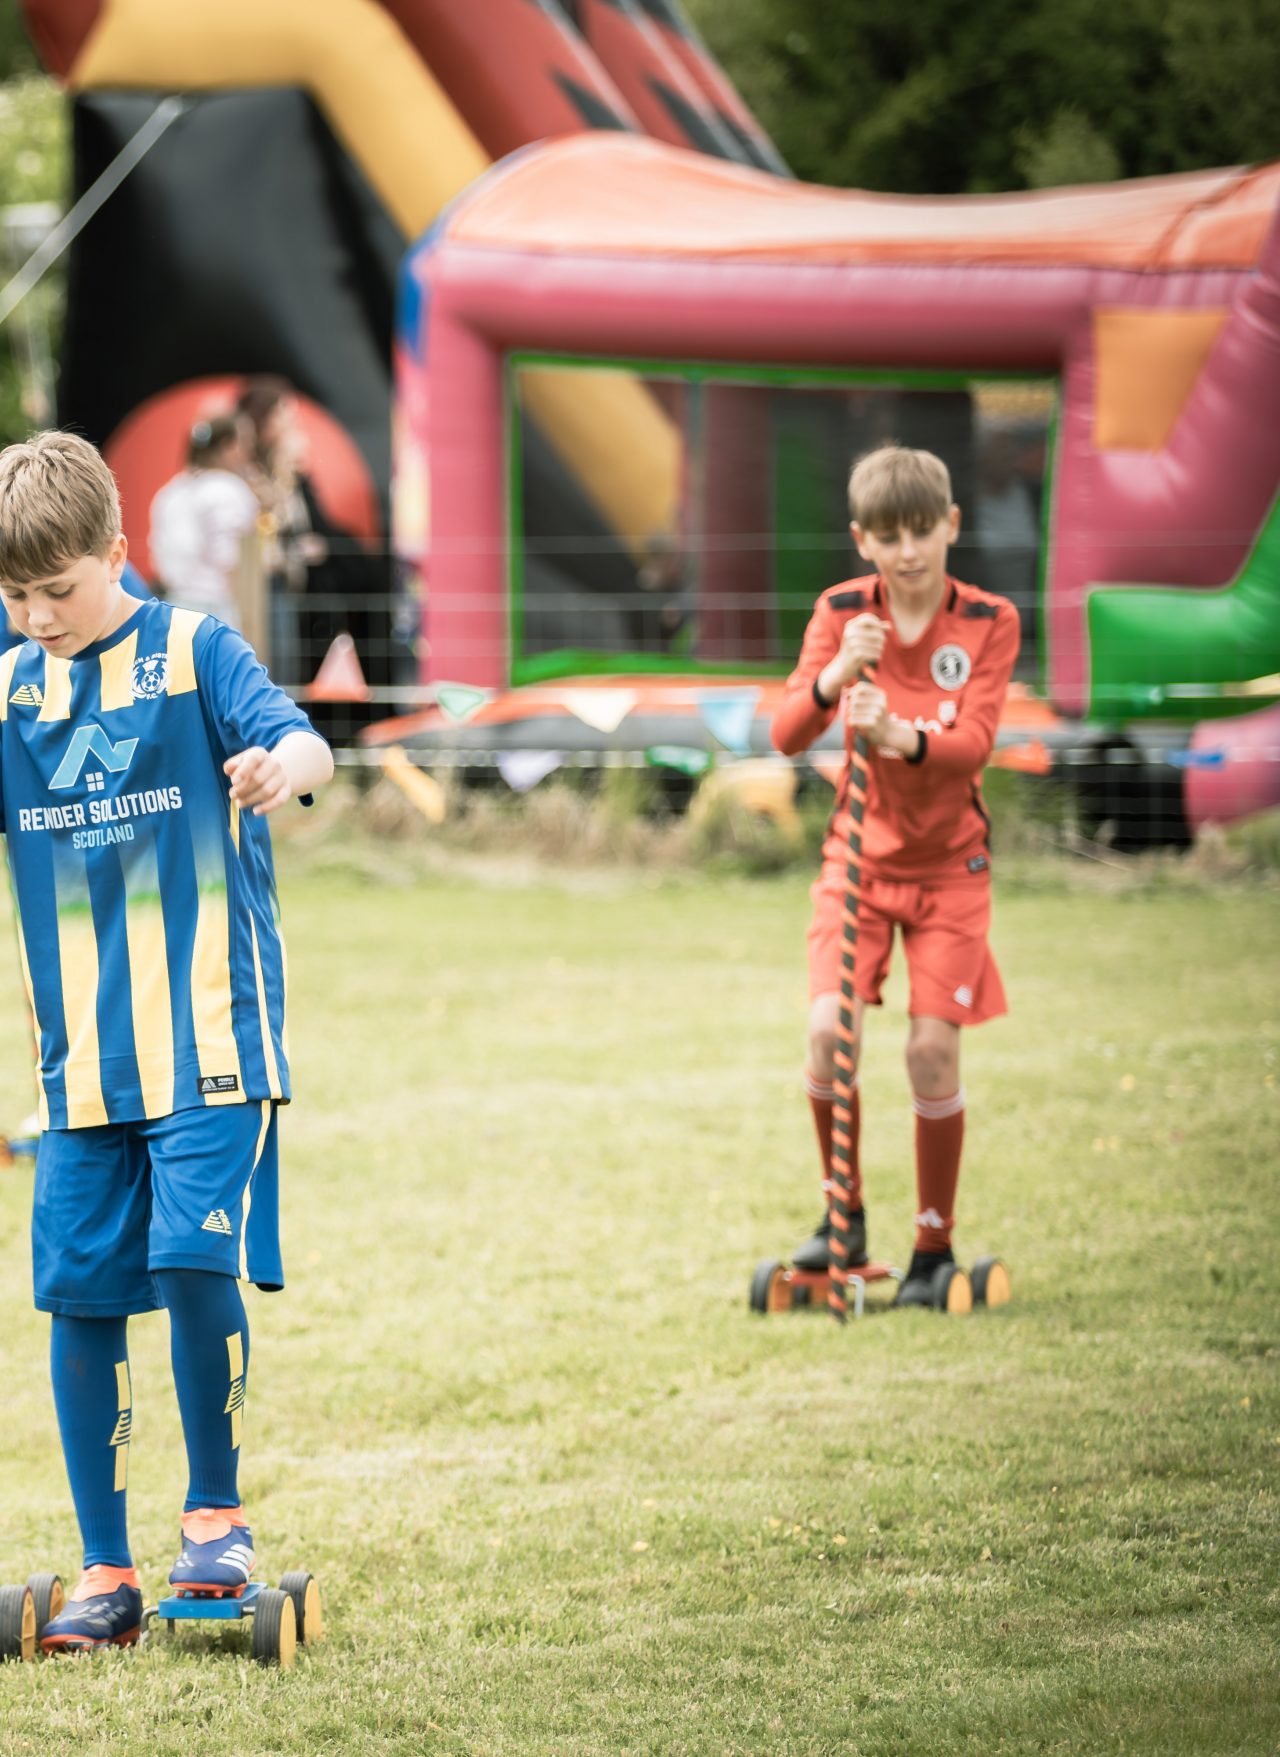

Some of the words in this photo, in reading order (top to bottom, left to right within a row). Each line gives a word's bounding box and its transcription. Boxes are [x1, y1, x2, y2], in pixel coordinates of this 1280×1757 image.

[19, 803, 86, 831] RENDER
[89, 786, 183, 823] SOLUTIONS
[72, 823, 135, 849] SCOTLAND
